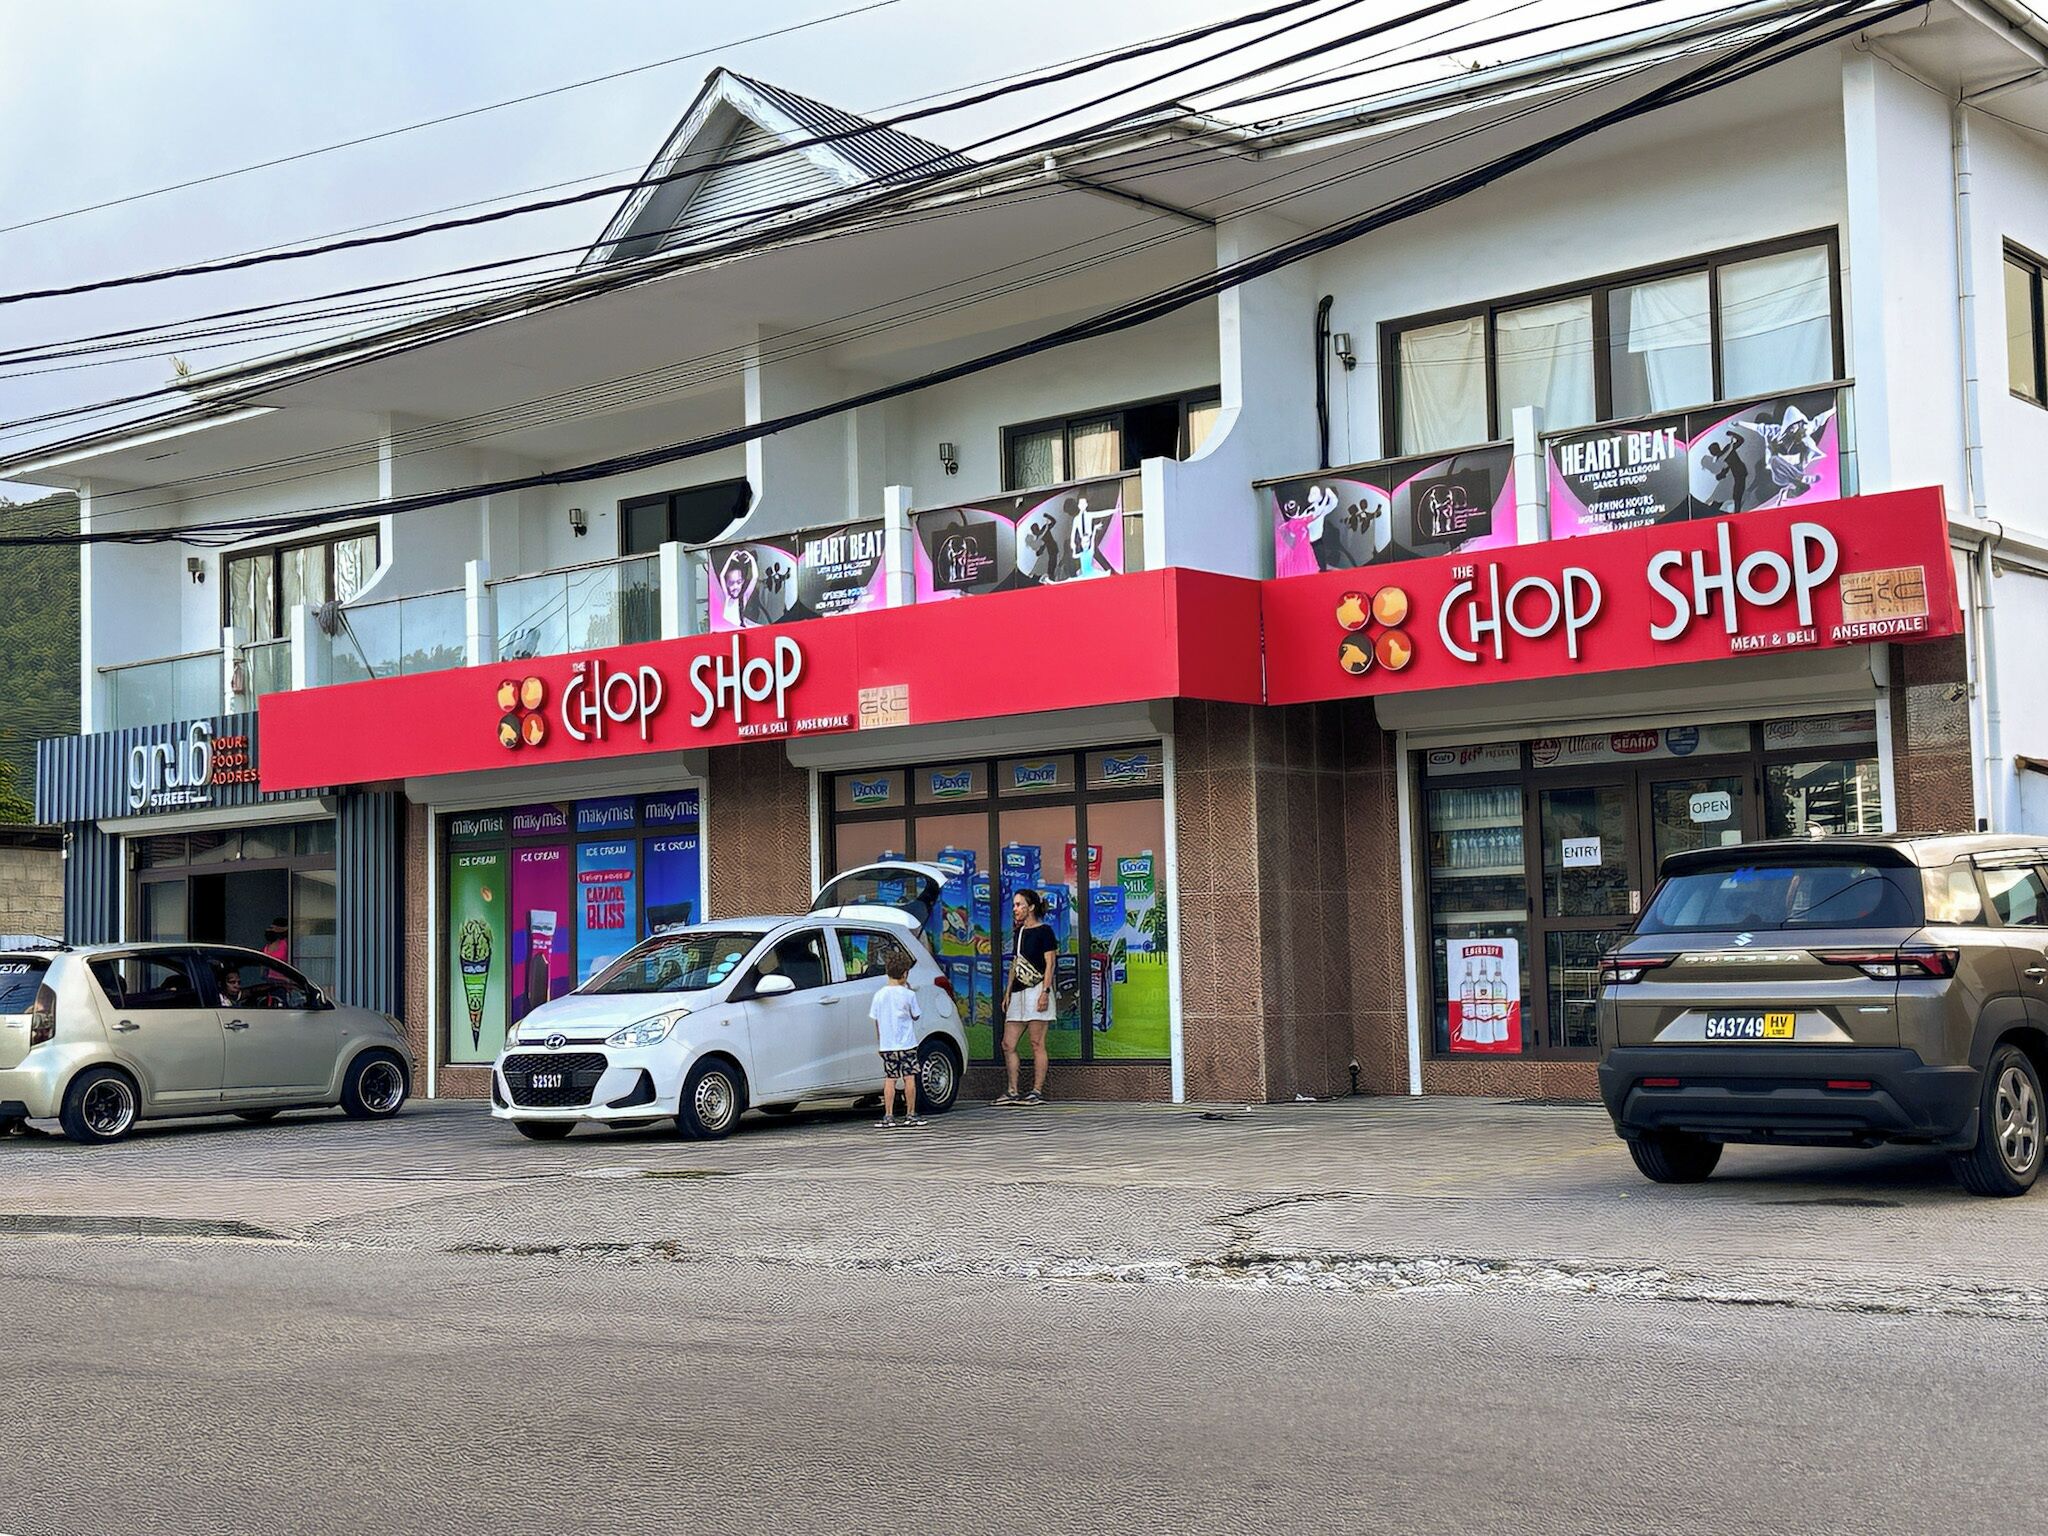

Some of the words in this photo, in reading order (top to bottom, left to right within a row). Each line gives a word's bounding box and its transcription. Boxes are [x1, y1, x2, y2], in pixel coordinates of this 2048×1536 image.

[1561, 437, 1622, 476] HEART
[1627, 427, 1677, 465] BEAT
[1618, 463, 1660, 477] BALLROOM
[1588, 500, 1625, 514] OPENING
[1626, 494, 1655, 508] HOURS
[805, 536, 846, 568] HEART
[850, 530, 883, 561] BEAT
[1452, 566, 1474, 579] THE
[1438, 563, 1601, 662] CHOP
[1647, 521, 1839, 641] SHOP
[1832, 617, 1922, 639] ANSEROYALE
[1731, 634, 1766, 650] MEAT
[1771, 633, 1782, 645] &
[1787, 630, 1815, 644] DELI
[562, 660, 663, 741] CHOP
[690, 633, 802, 728] SHOP
[738, 724, 760, 736] MEAT
[770, 721, 788, 733] DELI
[796, 715, 849, 731] ANSEROYALE
[212, 737, 243, 750] YOUR
[1613, 737, 1656, 750] SEARA
[130, 721, 212, 809] grub
[211, 754, 243, 768] FOOD
[212, 768, 260, 785] ADDRES
[150, 791, 193, 807] STREET
[1692, 800, 1729, 814] OPEN
[645, 801, 699, 820] MilkyMis
[586, 847, 598, 857] ICE
[600, 845, 627, 856] CREAM
[654, 842, 666, 852] ICE
[667, 840, 696, 851] CREAM
[1564, 846, 1599, 859] ENTRY
[520, 853, 532, 862] ICE
[533, 851, 560, 861] CREAM
[1123, 879, 1148, 892] Milk
[587, 902, 625, 930] BLISS
[1706, 1017, 1764, 1038] S43749
[1770, 1015, 1788, 1028] HV
